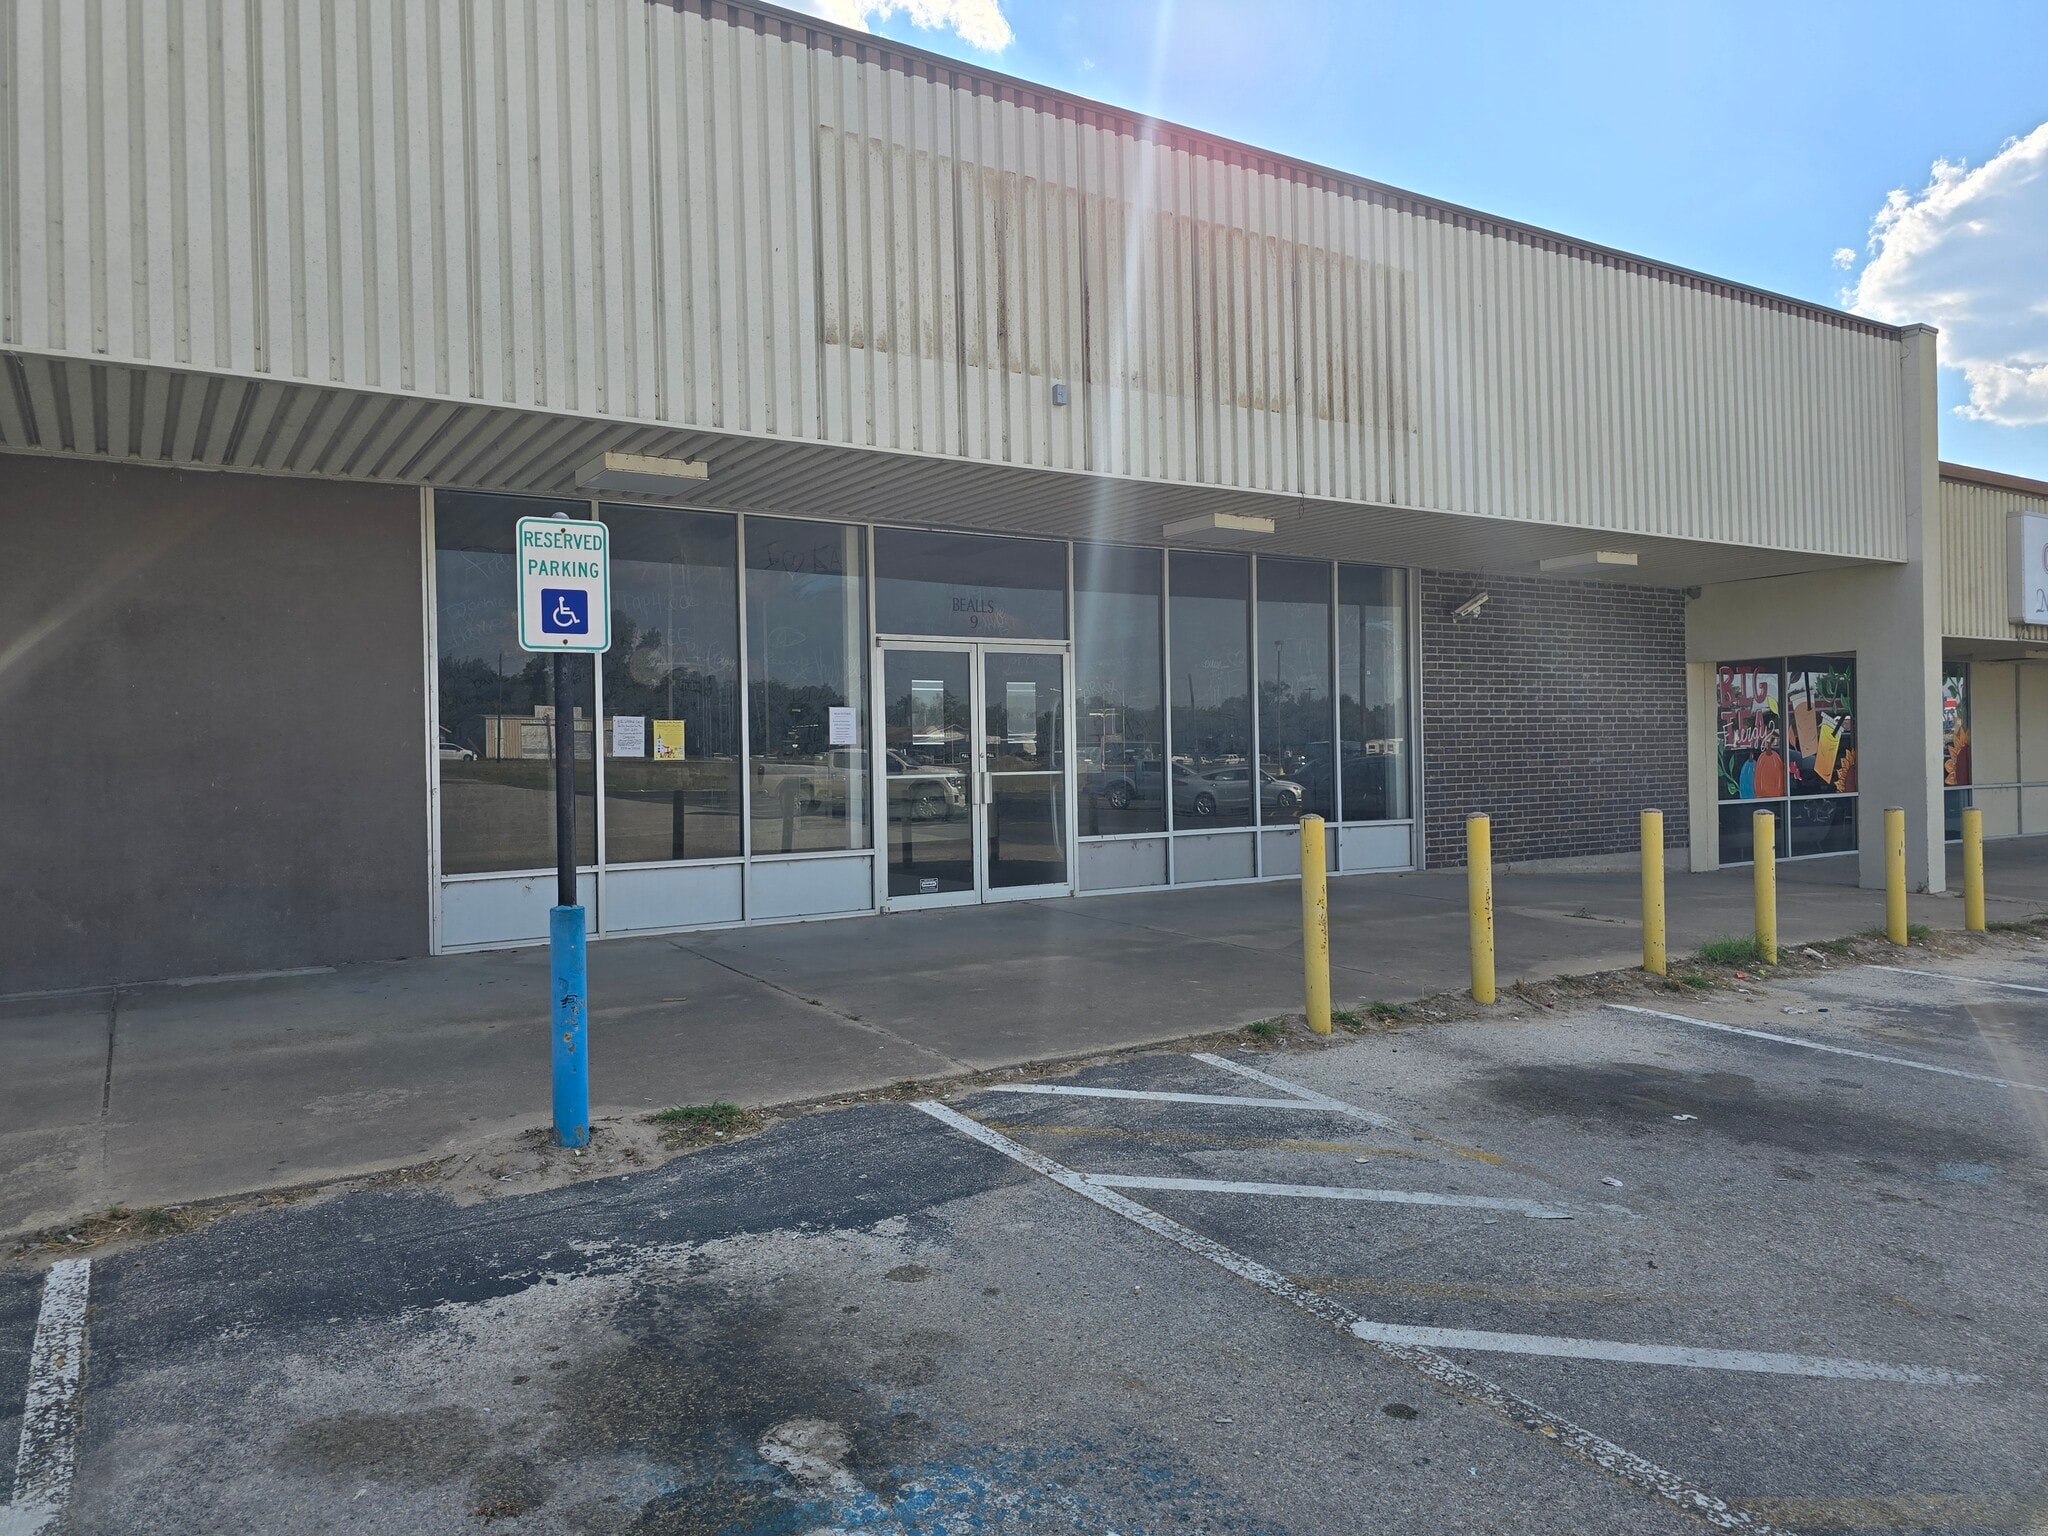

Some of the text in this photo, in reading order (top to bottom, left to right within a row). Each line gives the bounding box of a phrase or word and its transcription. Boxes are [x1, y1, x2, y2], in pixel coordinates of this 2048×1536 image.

[524, 531, 602, 551] RESERVED
[528, 559, 599, 579] PARKING
[952, 597, 995, 614] BEALLS
[969, 615, 979, 629] 9
[1719, 666, 1768, 708] BIG
[1717, 720, 1776, 752] Energy
